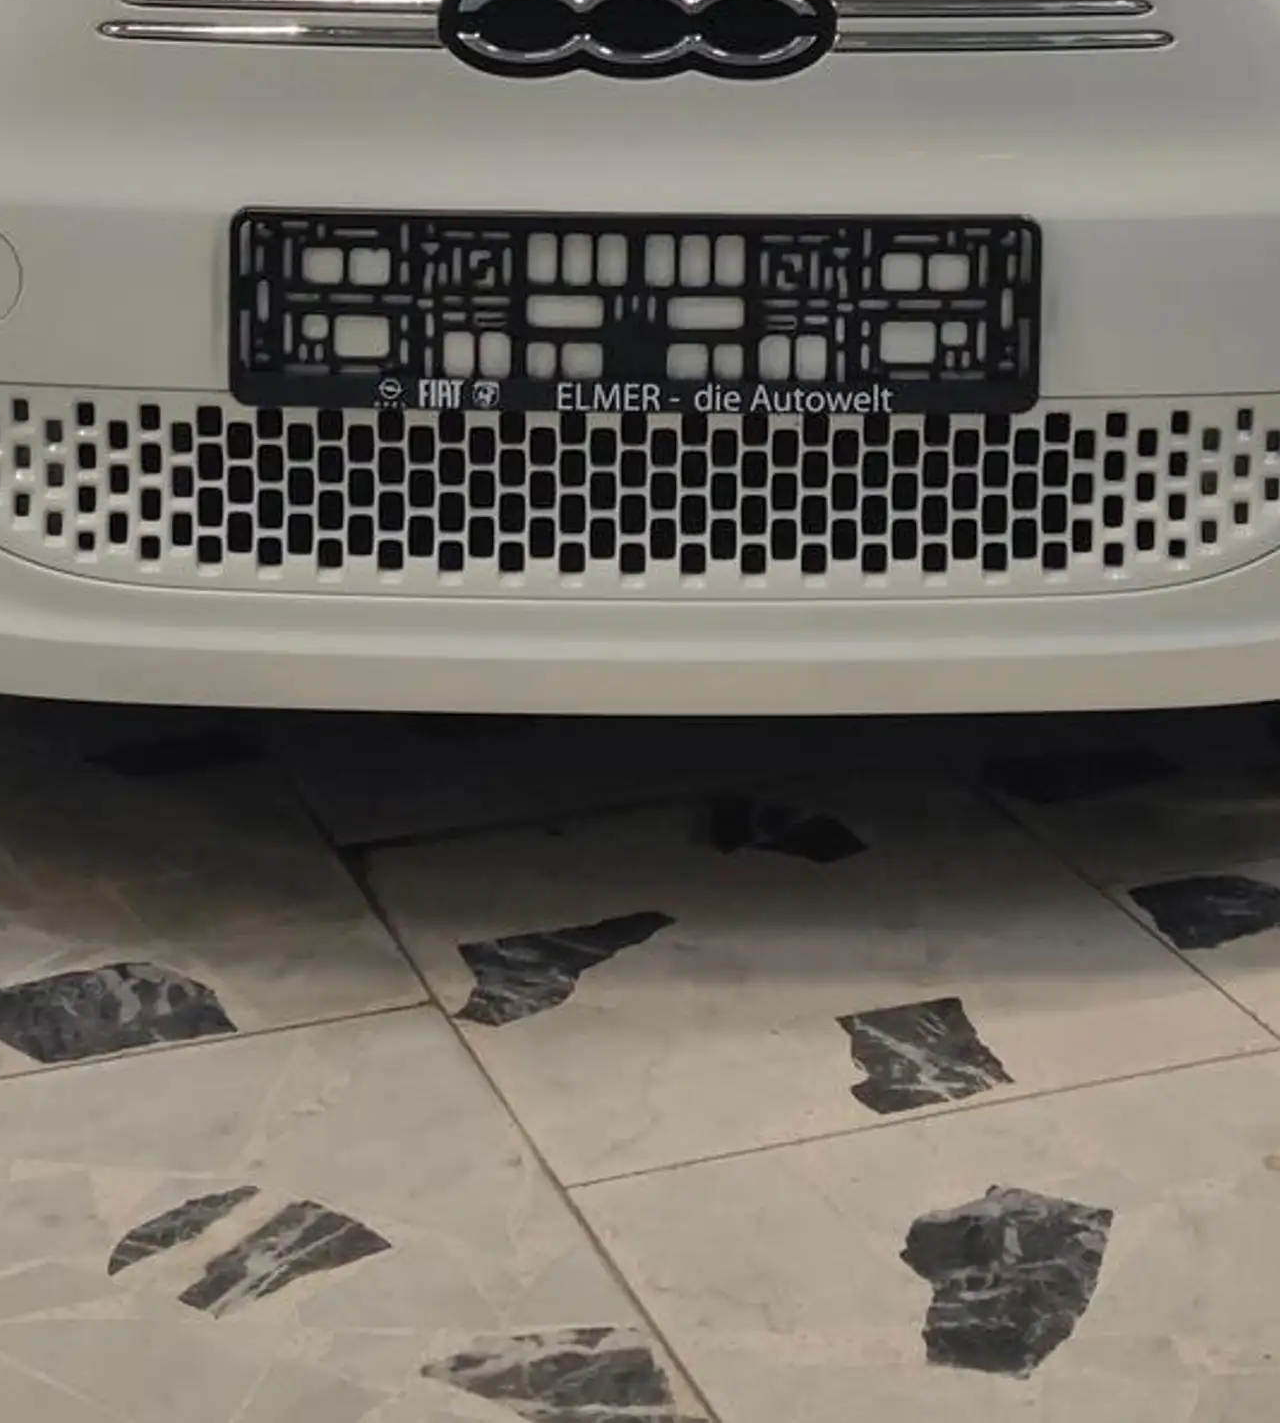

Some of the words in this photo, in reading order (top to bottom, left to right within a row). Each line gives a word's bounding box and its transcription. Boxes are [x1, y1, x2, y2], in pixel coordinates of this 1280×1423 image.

[419, 379, 466, 409] FIAT
[556, 383, 661, 412] ELMER
[694, 383, 741, 412] die
[749, 383, 894, 413] Autowelt
